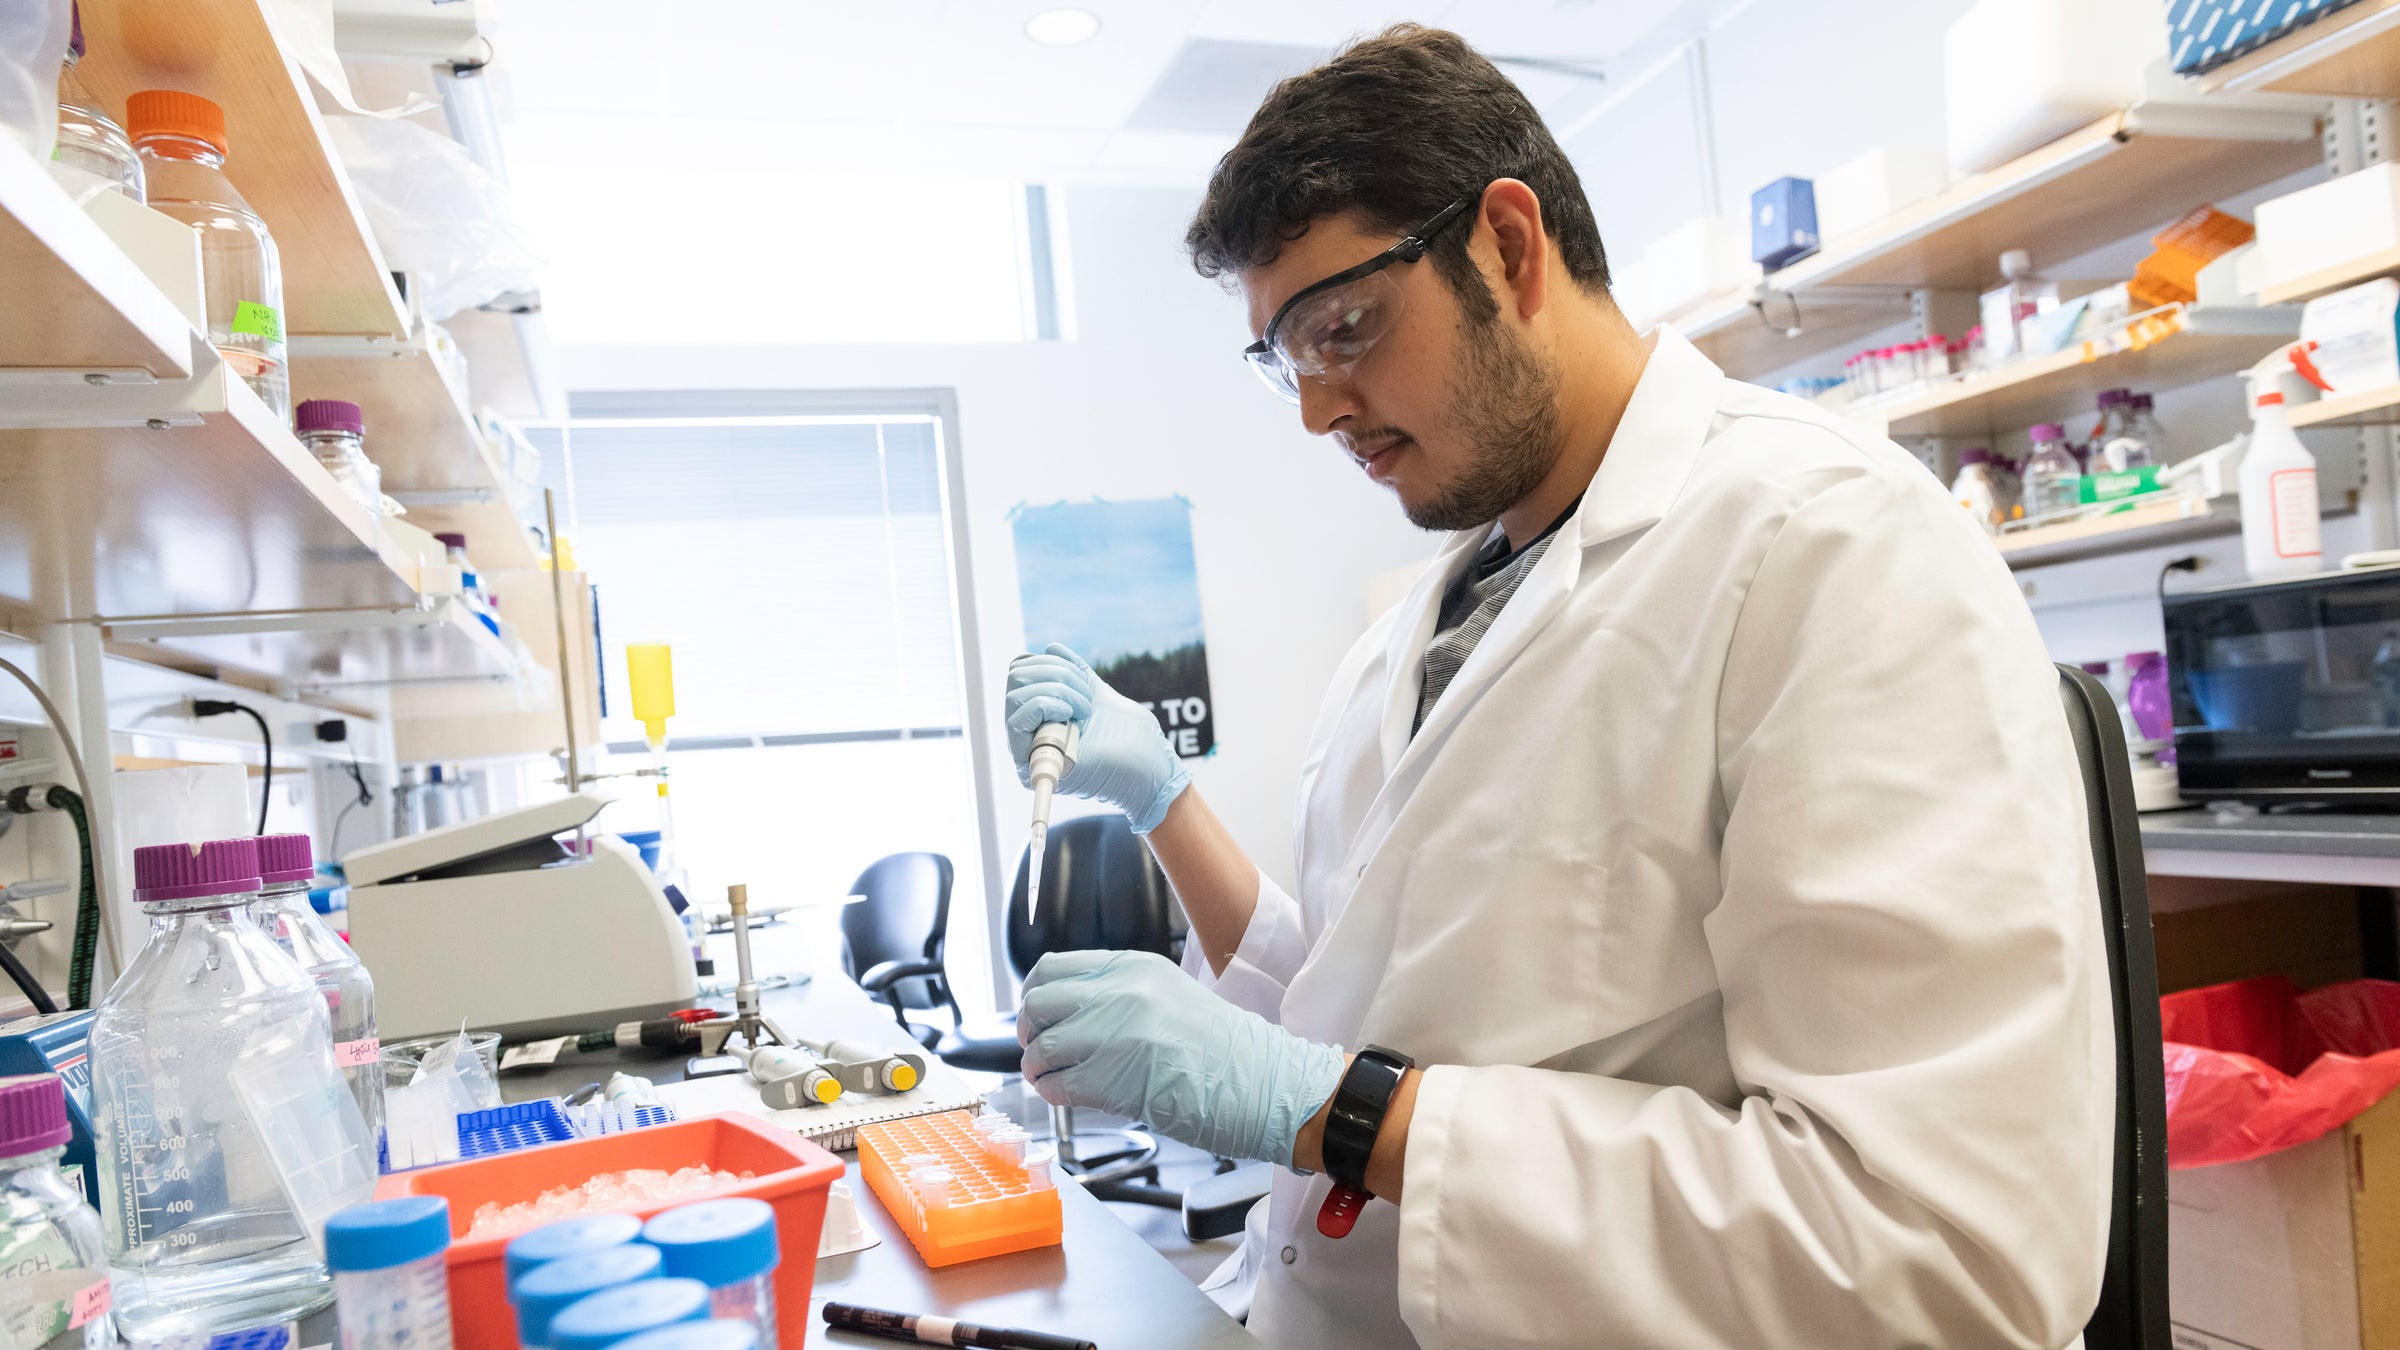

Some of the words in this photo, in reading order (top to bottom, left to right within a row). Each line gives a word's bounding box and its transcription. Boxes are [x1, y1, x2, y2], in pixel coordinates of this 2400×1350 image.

[1161, 696, 1207, 726] TO
[114, 1102, 129, 1164] VOLUMES
[159, 1136, 186, 1151] 600
[163, 1167, 190, 1183] 500
[122, 1171, 138, 1251] PPROXIMATE
[166, 1199, 193, 1214] 400
[169, 1232, 197, 1248] 300
